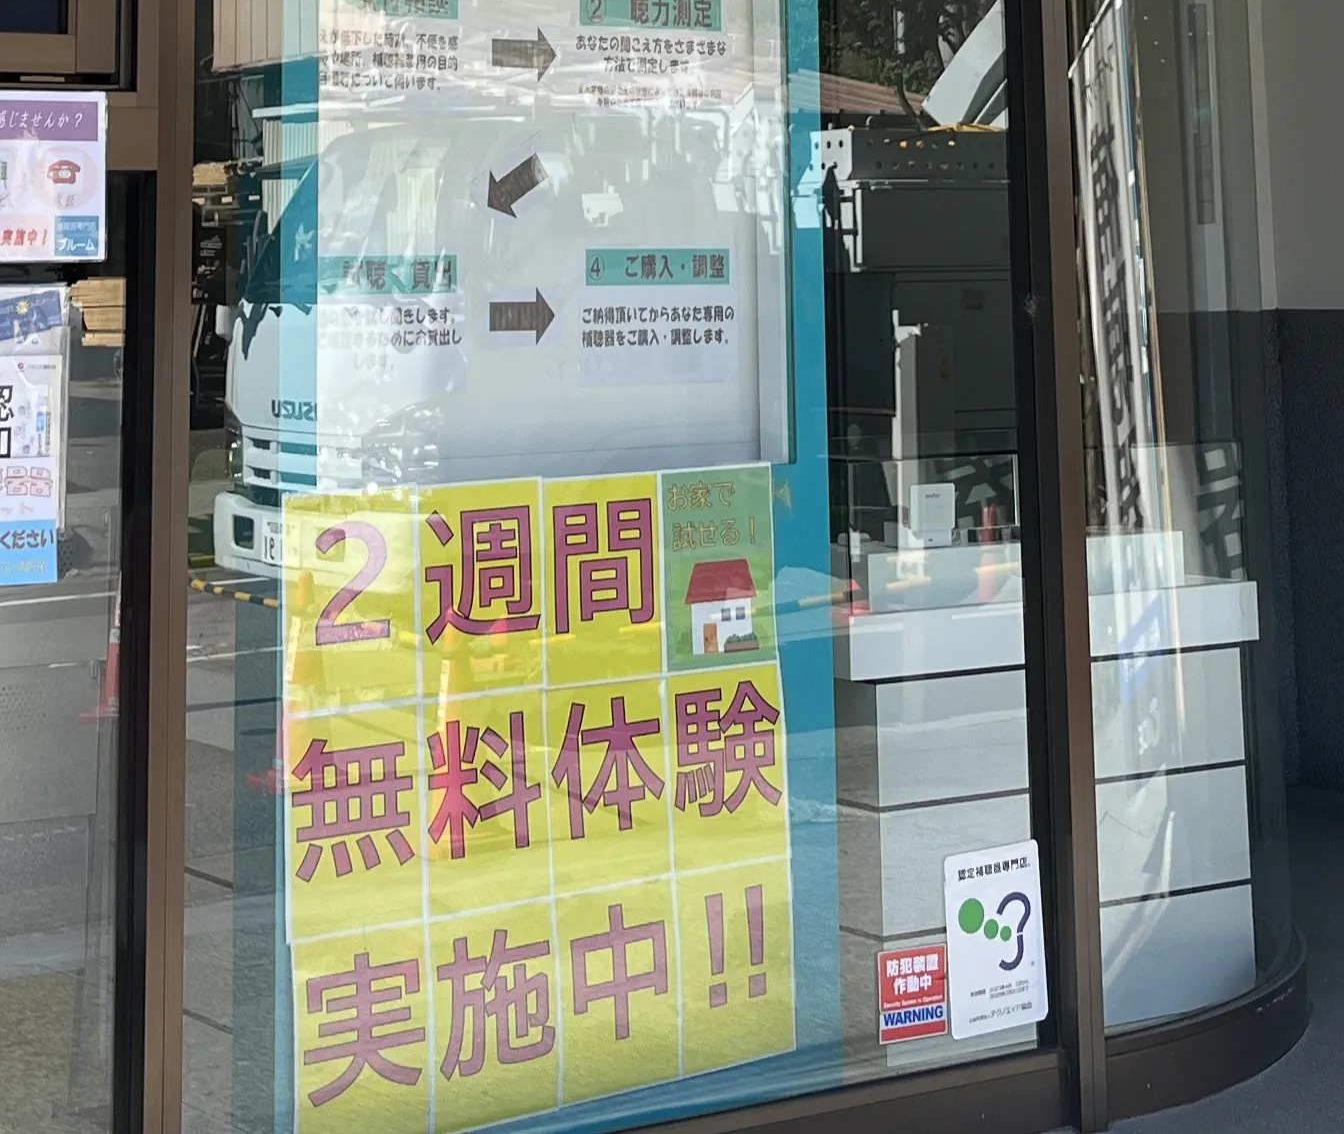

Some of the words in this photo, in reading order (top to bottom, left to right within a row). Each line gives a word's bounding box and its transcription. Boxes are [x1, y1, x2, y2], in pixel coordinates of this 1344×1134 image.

[575, 34, 727, 55] あなたの聞こえ方をさまざまな
[625, 253, 725, 280] ご購入・調整
[582, 305, 735, 325] ご納得頂いてからあなた専用の
[666, 481, 736, 512] お家で
[314, 496, 656, 647] 2週間
[290, 679, 784, 883] 無料体験
[885, 953, 939, 978] 防犯装置
[892, 974, 933, 996] 作動中
[883, 1004, 944, 1028] WARNING
